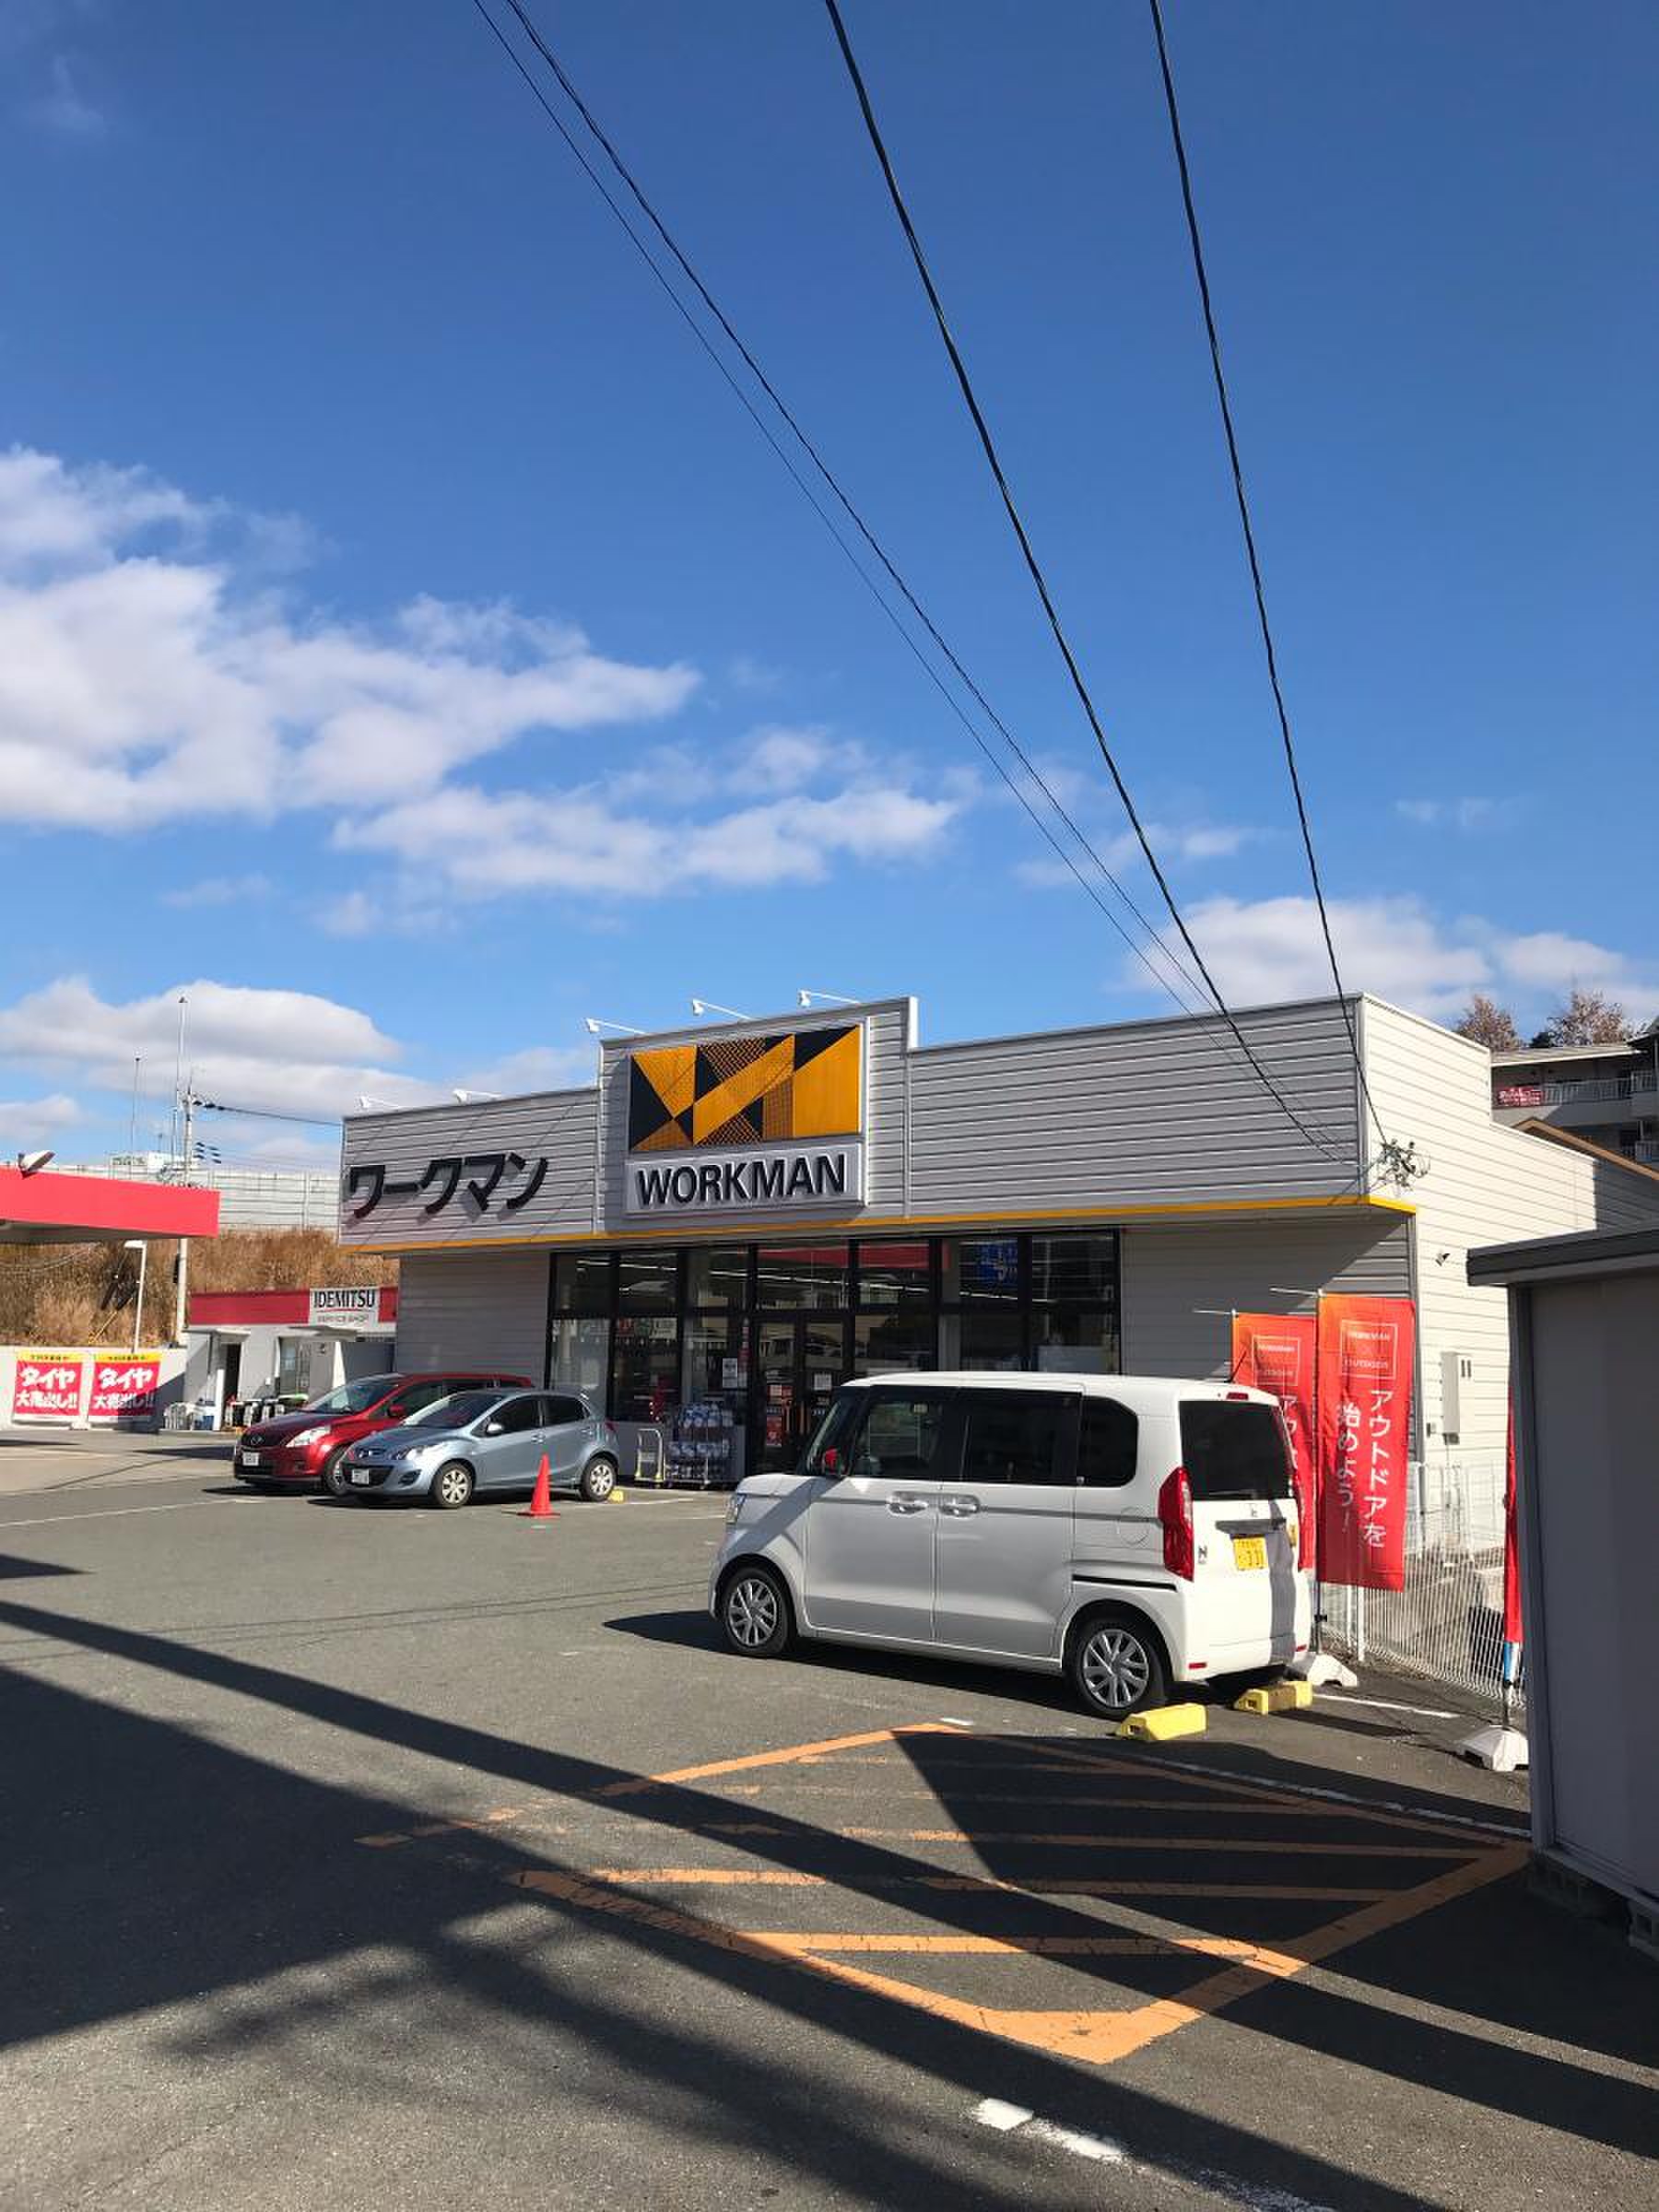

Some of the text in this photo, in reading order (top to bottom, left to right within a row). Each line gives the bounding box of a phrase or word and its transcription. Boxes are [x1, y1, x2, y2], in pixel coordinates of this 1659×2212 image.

[350, 1153, 547, 1218] ワークマン
[637, 1153, 844, 1205] WORKMAN
[313, 1290, 375, 1307] IDEMITSU
[19, 1366, 76, 1389] タイヤ
[99, 1367, 154, 1390] タイヤ
[1364, 1389, 1393, 1547] アウトドアを
